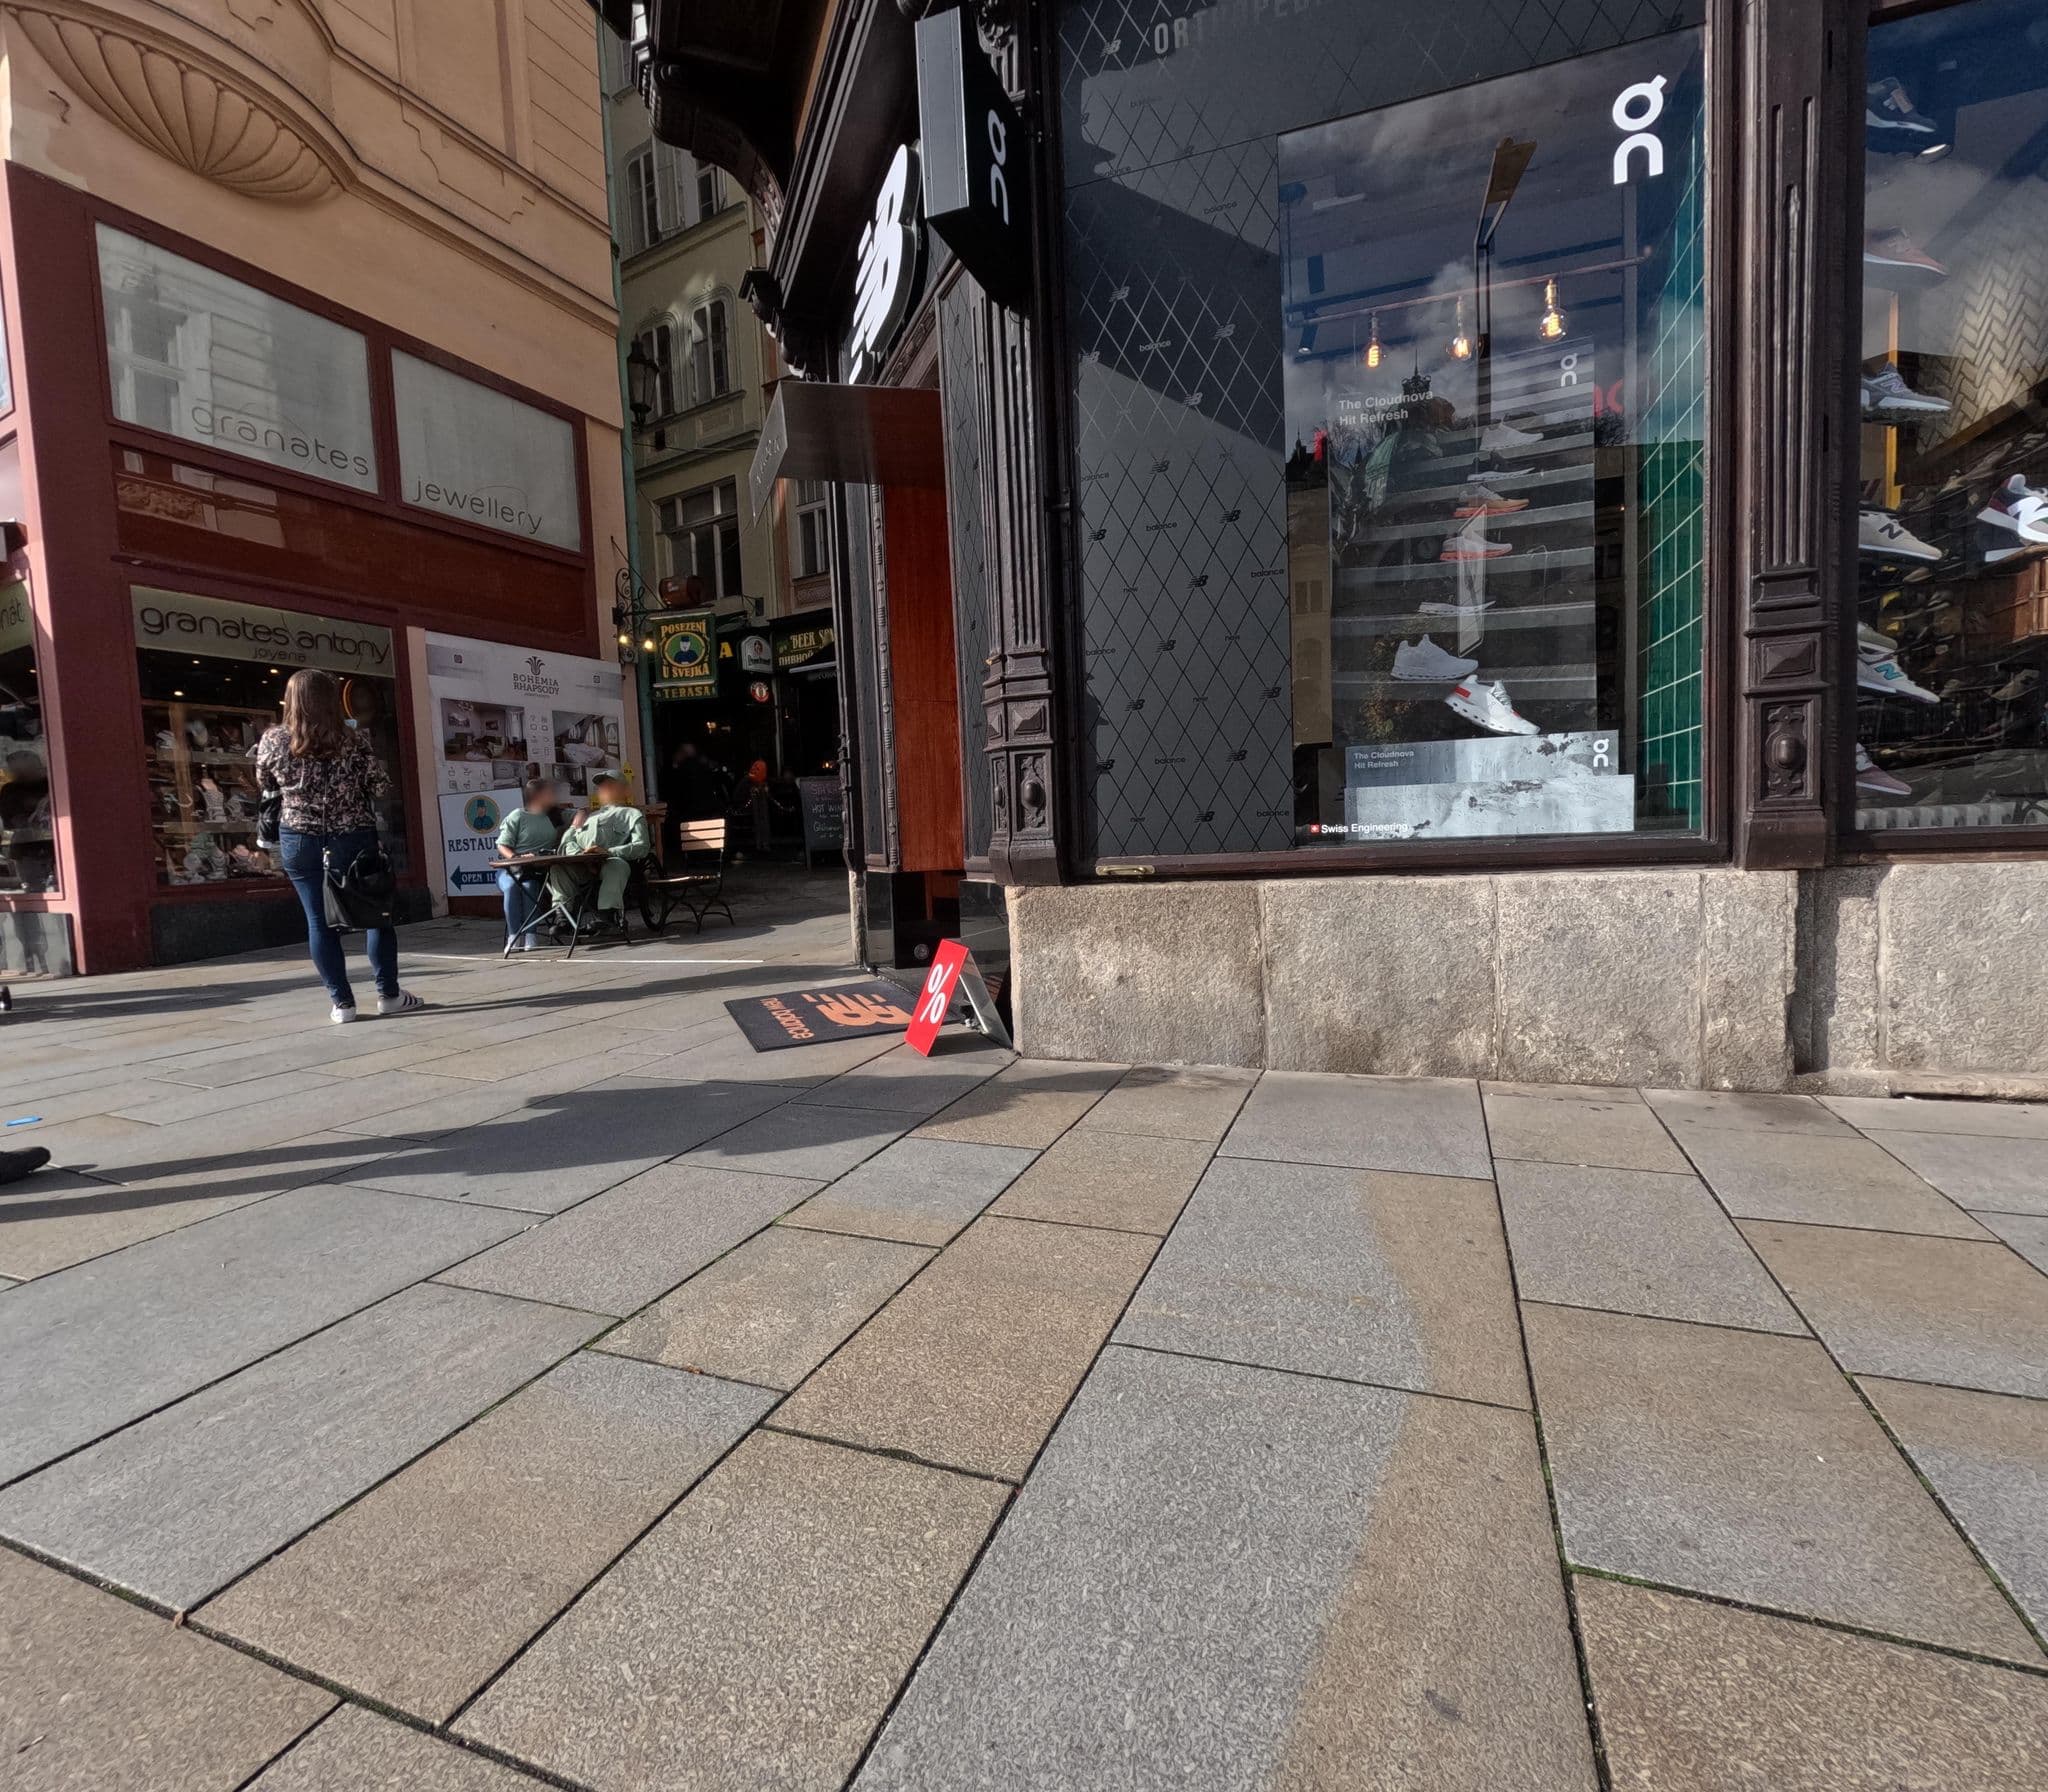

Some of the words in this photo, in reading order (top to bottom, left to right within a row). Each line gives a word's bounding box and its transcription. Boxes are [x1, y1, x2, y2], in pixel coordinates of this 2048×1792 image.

[1339, 400, 1361, 410] The
[1365, 391, 1433, 408] Cloudnova
[1339, 415, 1356, 426] Hit
[1360, 409, 1408, 424] Refresh
[191, 406, 369, 476] granates
[413, 476, 542, 535] jewellery
[1146, 521, 1177, 531] balance
[1250, 568, 1284, 577] balance
[140, 607, 289, 646] granates
[296, 630, 390, 664] antony
[790, 631, 816, 649] BEER
[513, 672, 559, 687] BOHEMIA
[513, 682, 560, 695] RHAPSODY
[1155, 757, 1185, 765] balance
[1370, 751, 1415, 759] Cloudnova
[1256, 809, 1289, 817] balance
[1321, 824, 1348, 833] Swiss
[1351, 823, 1409, 834] Engineering
[461, 872, 482, 883] OPEN
